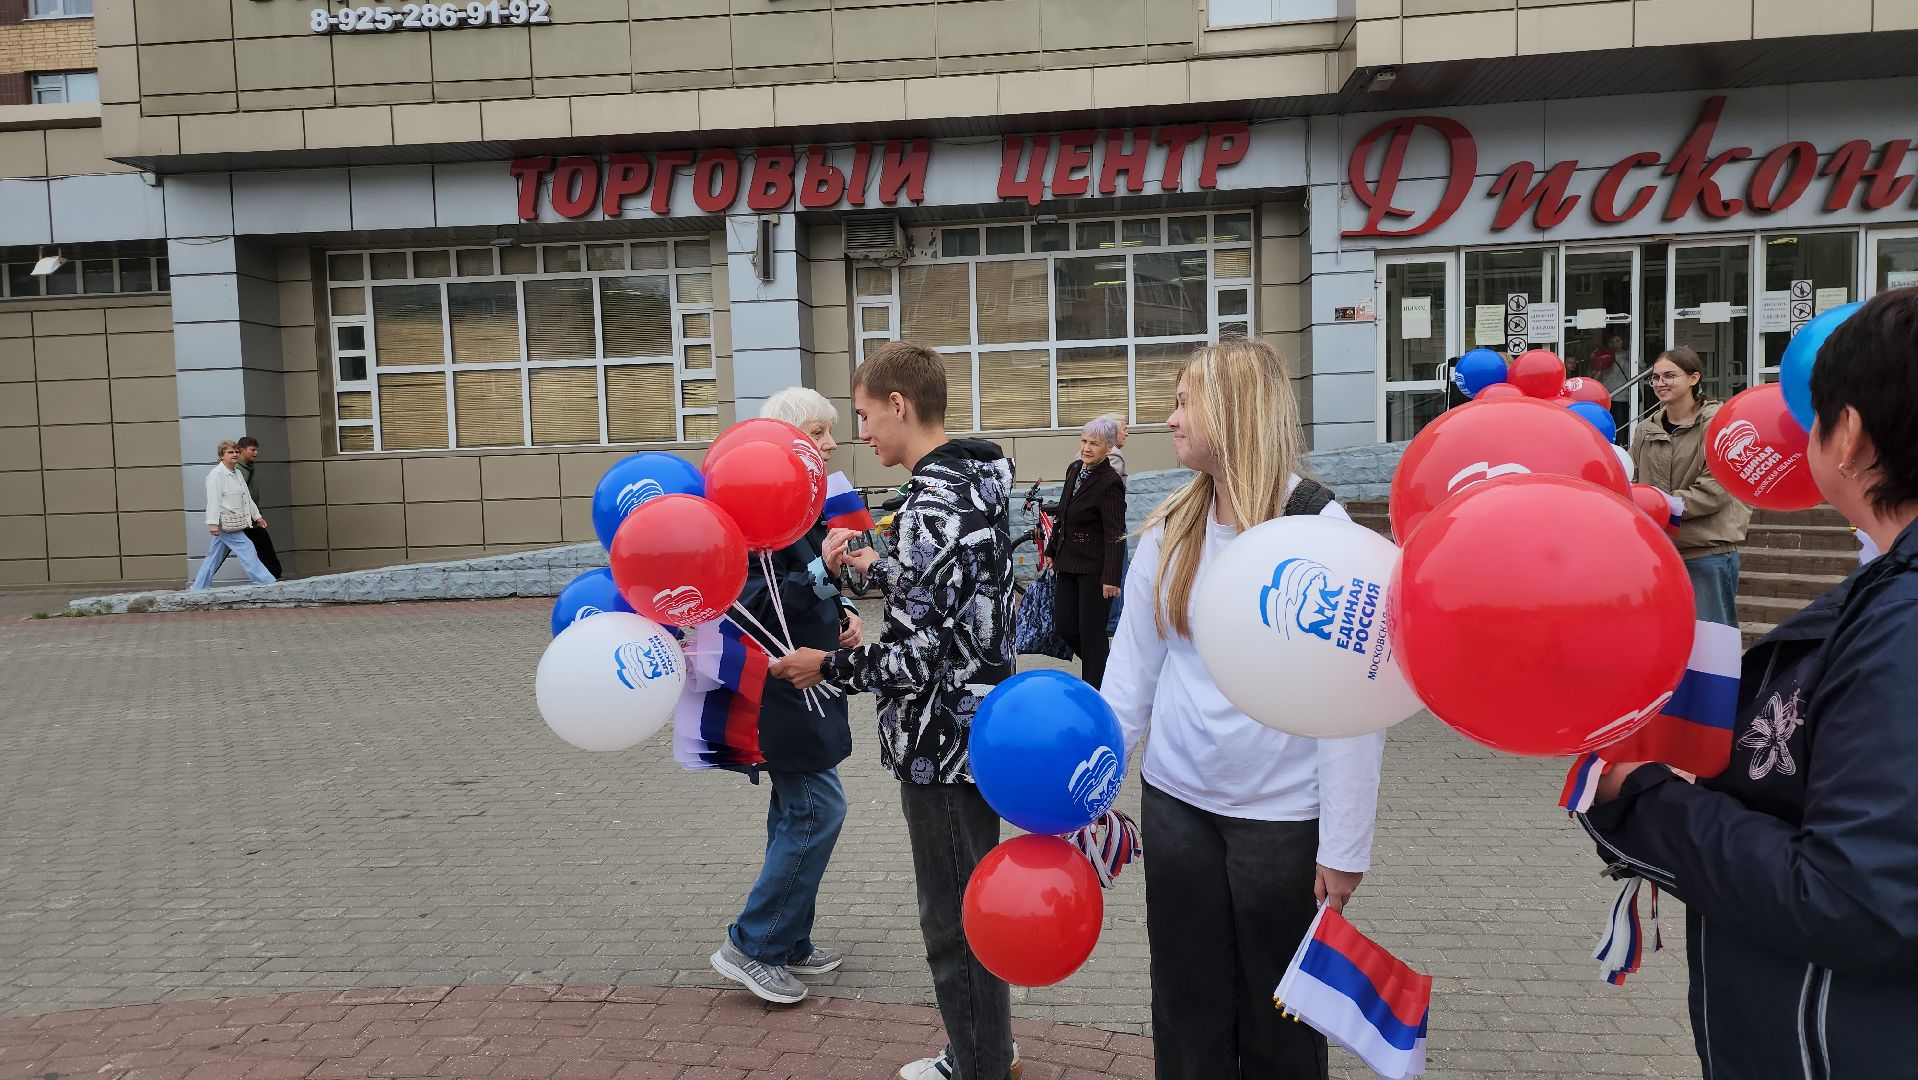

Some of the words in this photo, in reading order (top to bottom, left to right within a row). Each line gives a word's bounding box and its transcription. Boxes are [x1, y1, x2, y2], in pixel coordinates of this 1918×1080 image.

[310, 0, 551, 32] 8-925-286-91-92
[510, 141, 931, 222] ТОРГОВЫЙ
[996, 122, 1252, 206] ЦЕНТР
[1340, 96, 1917, 238] Дискон
[1739, 446, 1775, 480] ЕДИНАЯ
[1748, 453, 1782, 485] РОССИЯ
[1336, 577, 1365, 650] ЕДИНАЯ
[1353, 582, 1381, 655] РОССИЯ
